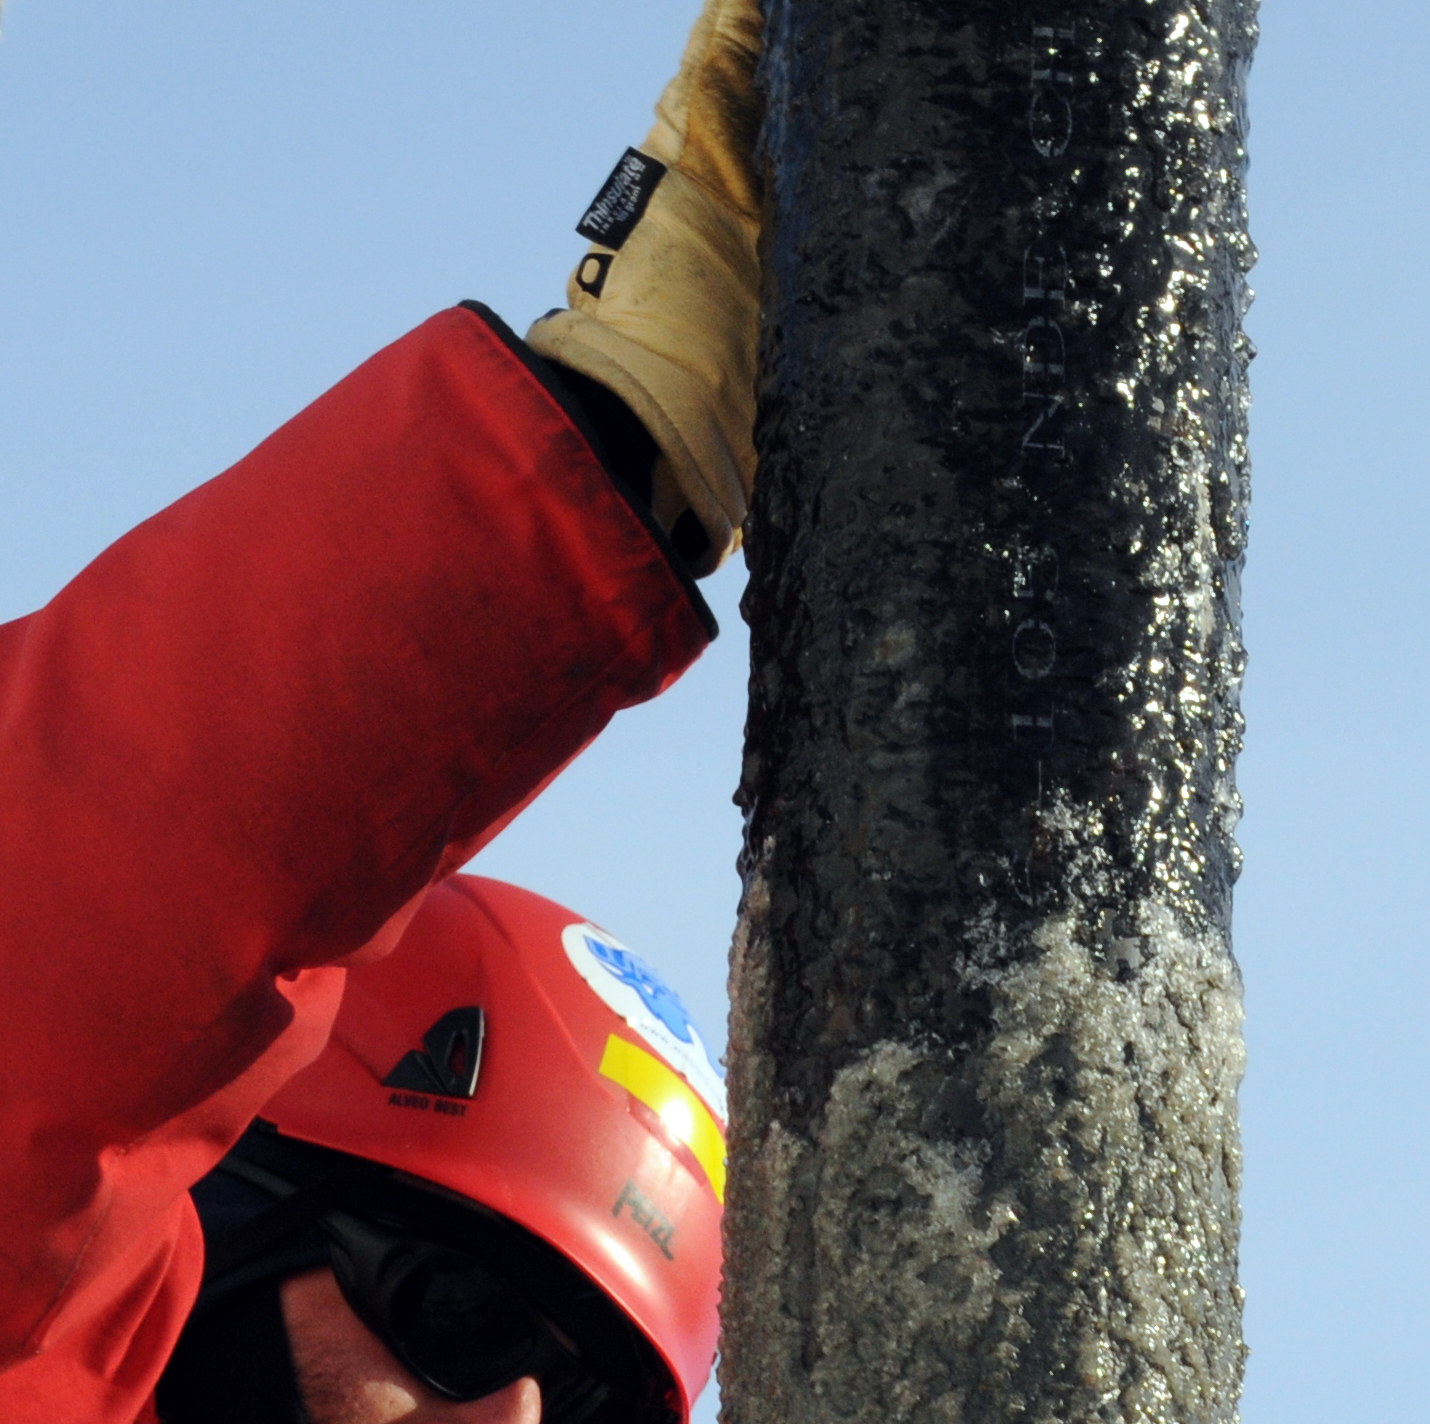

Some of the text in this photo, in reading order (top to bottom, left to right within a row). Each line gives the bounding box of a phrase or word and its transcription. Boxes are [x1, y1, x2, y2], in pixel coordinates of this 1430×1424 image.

[582, 156, 641, 230] Thinsulate
[388, 1092, 467, 1116] ALVEO BEST
